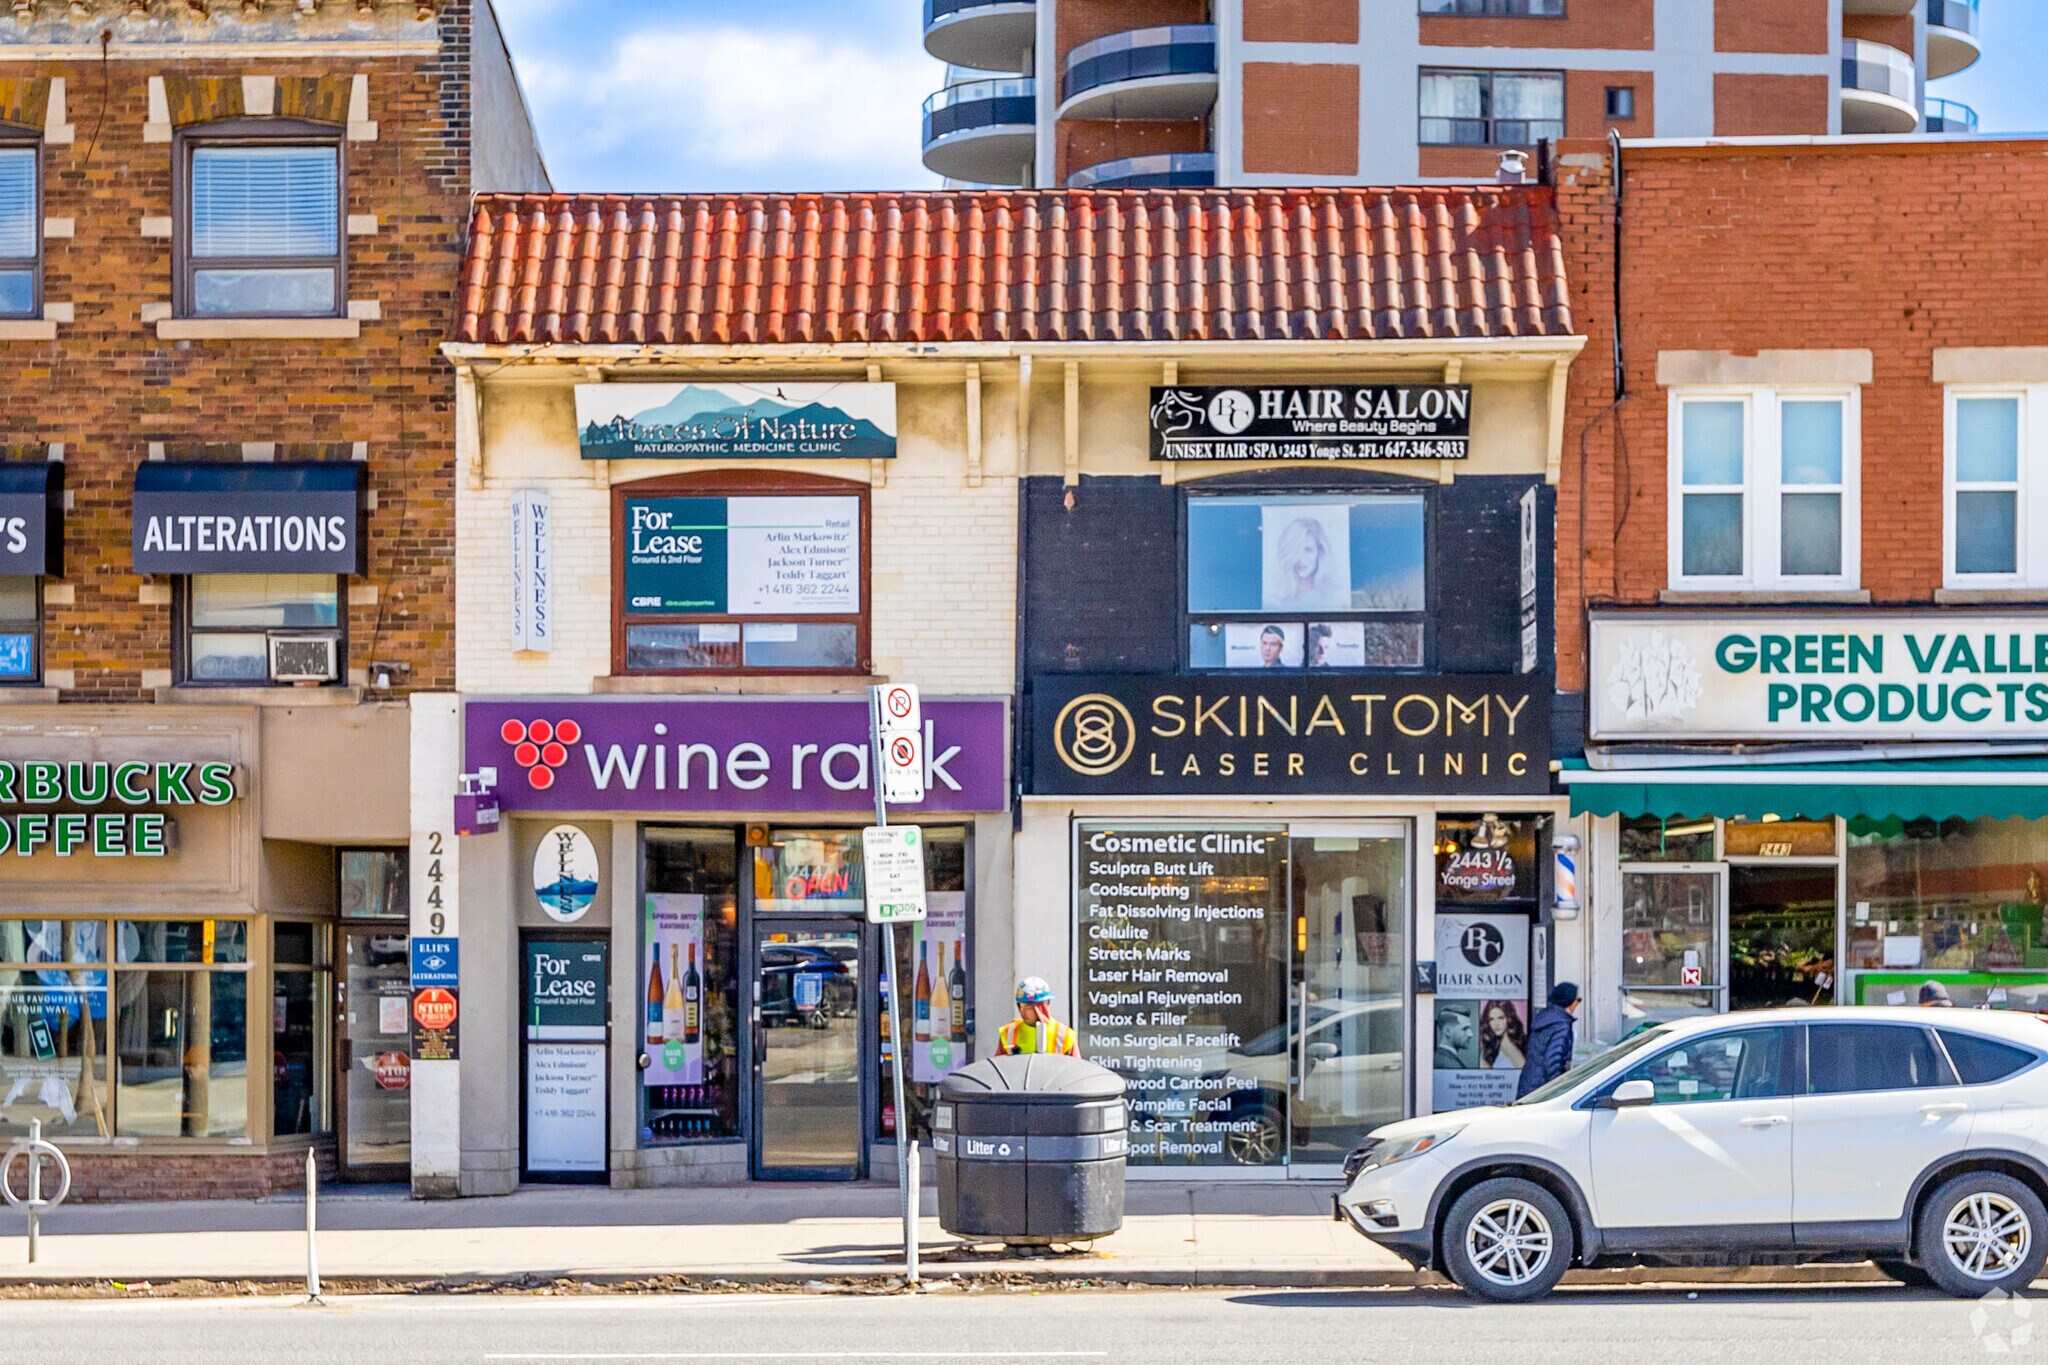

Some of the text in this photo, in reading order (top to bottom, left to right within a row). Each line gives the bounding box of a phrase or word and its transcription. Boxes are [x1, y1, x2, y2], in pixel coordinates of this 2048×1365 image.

[1259, 390, 1345, 419] HAIR
[1354, 389, 1469, 419] SALON
[712, 409, 756, 441] Of
[760, 417, 857, 441] Nature
[1293, 420, 1437, 435] Where Beauty Begins
[634, 442, 842, 453] NATUROPATHIC MEDICINE CLINIC
[1166, 443, 1213, 458] UNISEX
[1215, 443, 1248, 458] HAIR
[1254, 443, 1278, 458] SPA
[1283, 444, 1308, 458] 2443
[1309, 443, 1342, 460] Yonge
[1342, 443, 1357, 458] St.
[1358, 443, 1380, 458] 2FL
[631, 506, 673, 530] For
[825, 520, 850, 528] Retail
[143, 516, 346, 553] ALTERATIONS
[631, 530, 703, 554] Lease
[779, 546, 801, 554] Alex
[631, 555, 702, 564] Ground & 2nd Floor
[768, 557, 806, 568] Jackson
[511, 502, 522, 635] WELLNESS
[531, 504, 548, 638] WELLNESS
[776, 570, 805, 581] Teddy
[758, 584, 850, 594] +1 416 362 2244
[631, 597, 661, 607] CBRE
[1715, 634, 1884, 673] GREEN
[1768, 683, 2048, 722] PRODUCTS
[1151, 693, 1530, 737] SKINATOMY
[583, 719, 963, 791] wine rak
[1151, 752, 1528, 776] LASER CLINIC
[0, 813, 165, 858] FFEE
[1090, 833, 1265, 853] Cosmetic Clinic
[1089, 861, 1214, 878] Sculptra Butt Lift
[1450, 854, 1492, 870] 2443
[555, 832, 578, 915] WELLNESS
[1441, 872, 1516, 889] Yonge Street
[427, 832, 446, 936] 2449
[785, 872, 849, 900] OPEN
[1089, 882, 1190, 900] Coolsculpting
[652, 912, 678, 920] SPRING
[1089, 904, 1265, 922] Fat Dissolving Injections
[1089, 926, 1149, 939] Cellulite
[1089, 947, 1191, 961] Stretch Marks
[1467, 927, 1501, 966] BC
[534, 953, 570, 975] For
[412, 972, 458, 980] ALTERATIONS
[1089, 968, 1228, 983] Laser Hair Removal
[1438, 973, 1523, 985] HAIR SALON
[534, 975, 596, 996] Lease
[418, 1002, 453, 1014] STOP
[1089, 991, 1242, 1008] Vaginal Rejuvenation
[17, 1005, 42, 1014] YOUR
[1089, 1012, 1188, 1026] Botox & Filler
[1089, 1033, 1241, 1050] Non Surgical Facelift
[378, 1065, 409, 1077] STOP
[1089, 1055, 1203, 1072] Skin Tightening
[1124, 1076, 1258, 1090] wood Carbon Peel
[1125, 1097, 1232, 1114] Vampire Facial
[1130, 1119, 1257, 1133] & Scar Treatment
[967, 1139, 995, 1155] Litter
[1126, 1141, 1223, 1157] Spot Removal
